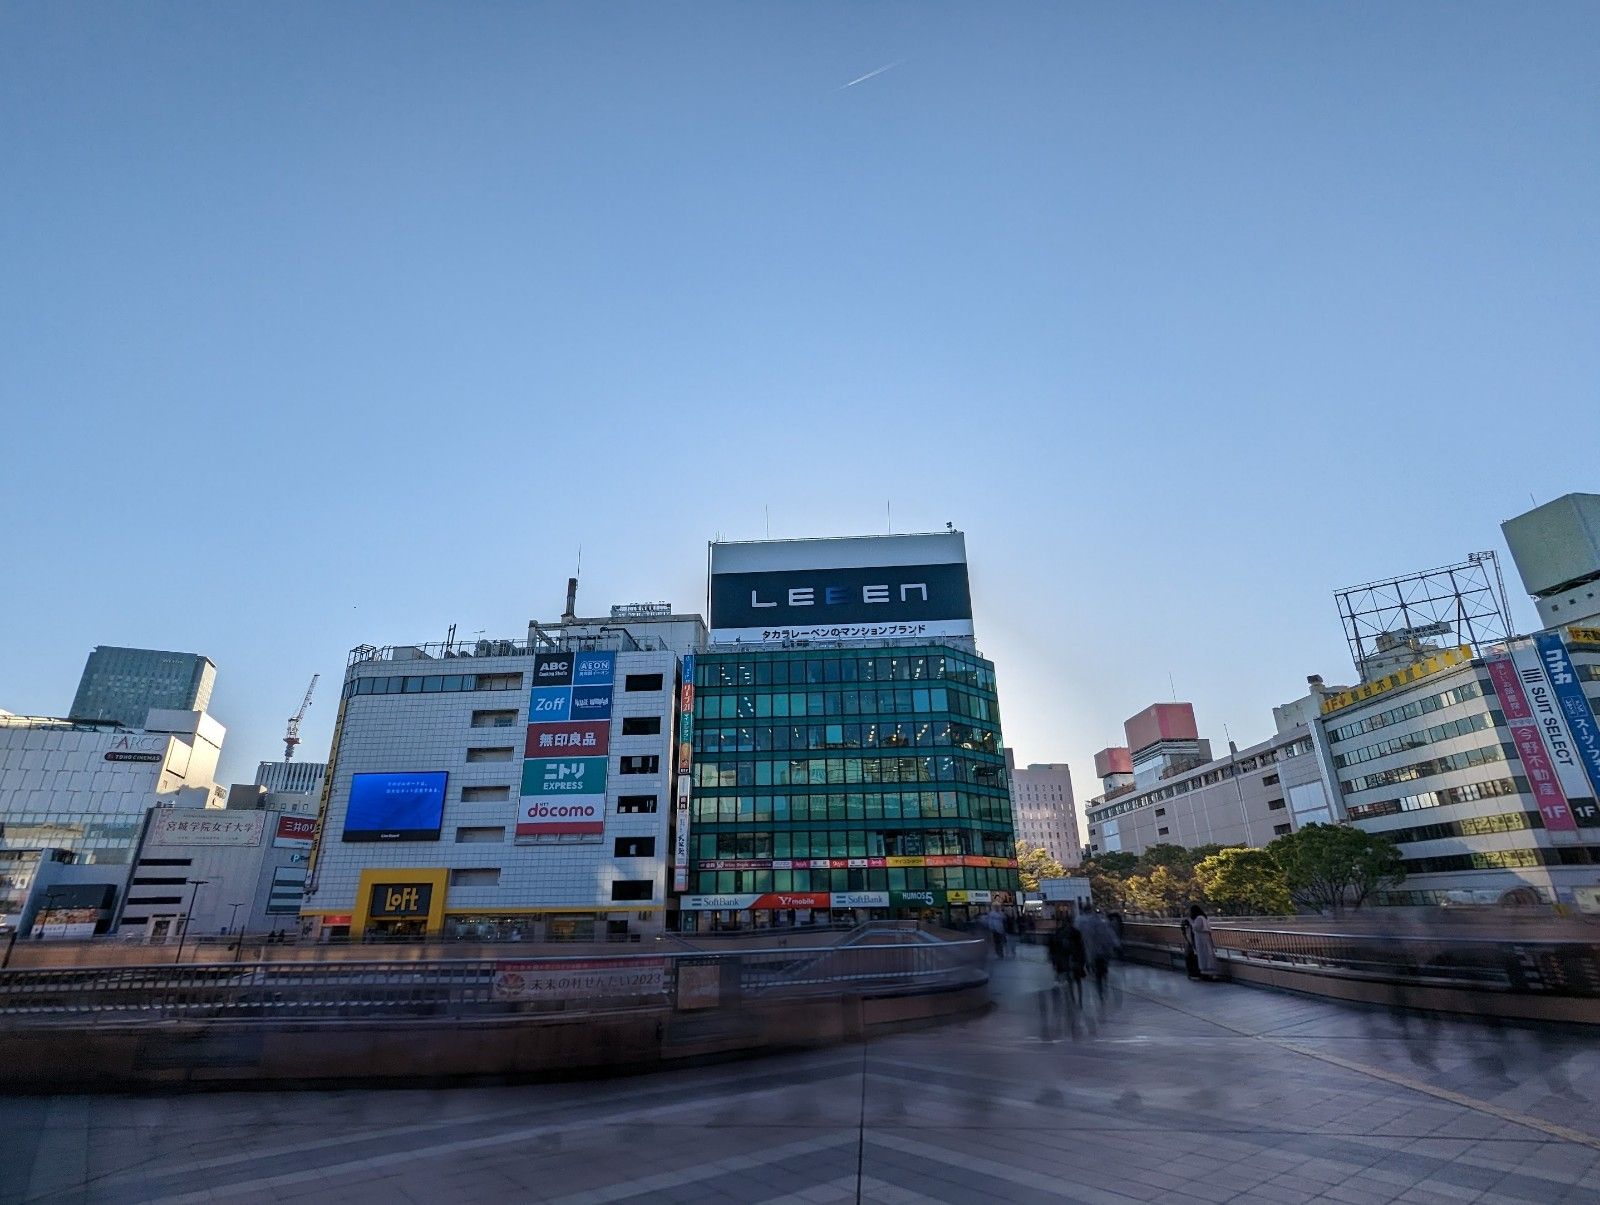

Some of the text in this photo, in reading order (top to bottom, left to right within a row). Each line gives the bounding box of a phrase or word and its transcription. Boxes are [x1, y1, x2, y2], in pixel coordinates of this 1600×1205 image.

[763, 624, 926, 639] タカラレーベンのマンションブランド
[540, 661, 569, 671] ABC
[580, 661, 609, 671] AEON
[535, 697, 566, 711] Zoff
[1532, 687, 1574, 767] SUIT SELECT
[110, 736, 165, 751] PARCO
[539, 732, 596, 747] 無印良品
[1517, 728, 1556, 795] 今野不動産
[544, 763, 585, 780] ニトリ
[543, 781, 583, 790] EXPRESS
[528, 803, 595, 818] docomo
[1543, 805, 1567, 819] 1F
[1574, 805, 1596, 818] 1F
[166, 821, 254, 832] 宮城学院女子大学
[703, 897, 740, 906] SoftBank
[848, 894, 883, 905] SoftBank
